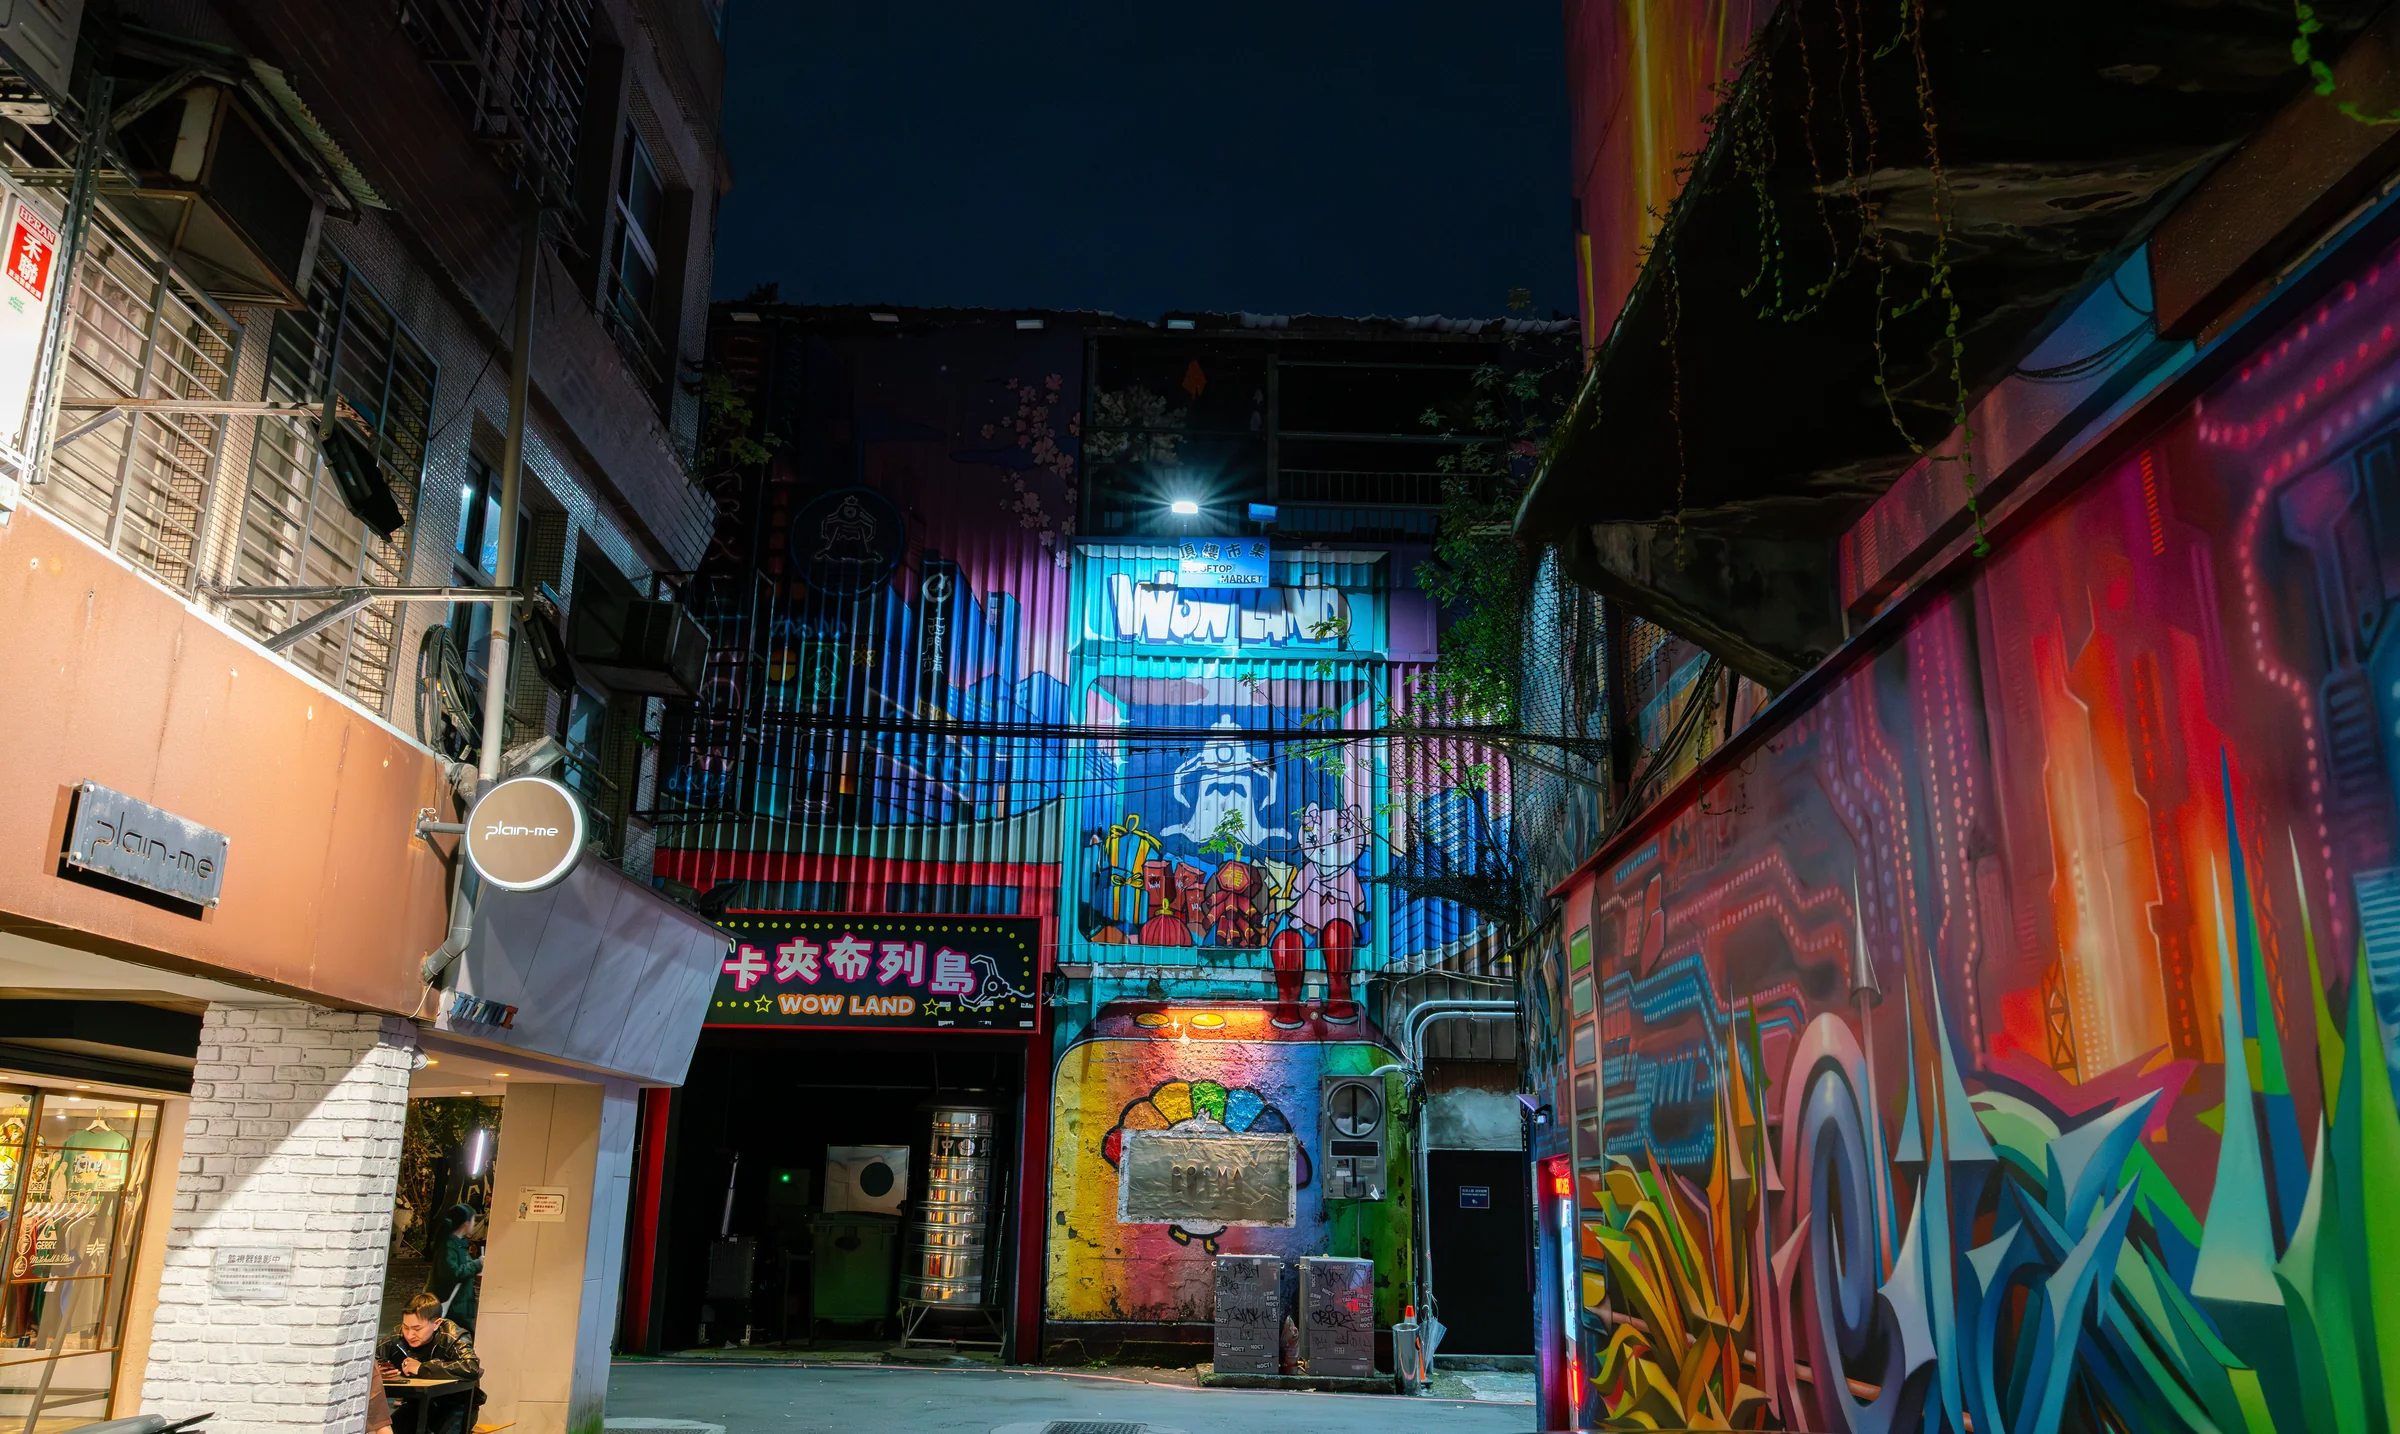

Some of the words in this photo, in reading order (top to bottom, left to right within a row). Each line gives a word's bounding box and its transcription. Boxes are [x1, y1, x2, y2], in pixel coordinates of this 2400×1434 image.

[20, 207, 55, 243] HERAN
[17, 232, 43, 285] 禾聯
[1179, 541, 1267, 560] 頂樓市集
[1220, 574, 1263, 584] MARKET
[1239, 572, 1352, 642] LAND
[484, 821, 559, 841] plain-me
[90, 811, 214, 880] plain-me
[723, 934, 975, 994] 卡夾布列島
[779, 995, 844, 1014] WOW
[851, 996, 915, 1015] LAND
[36, 1240, 57, 1250] GERRY
[1321, 1287, 1335, 1297] NOCT
